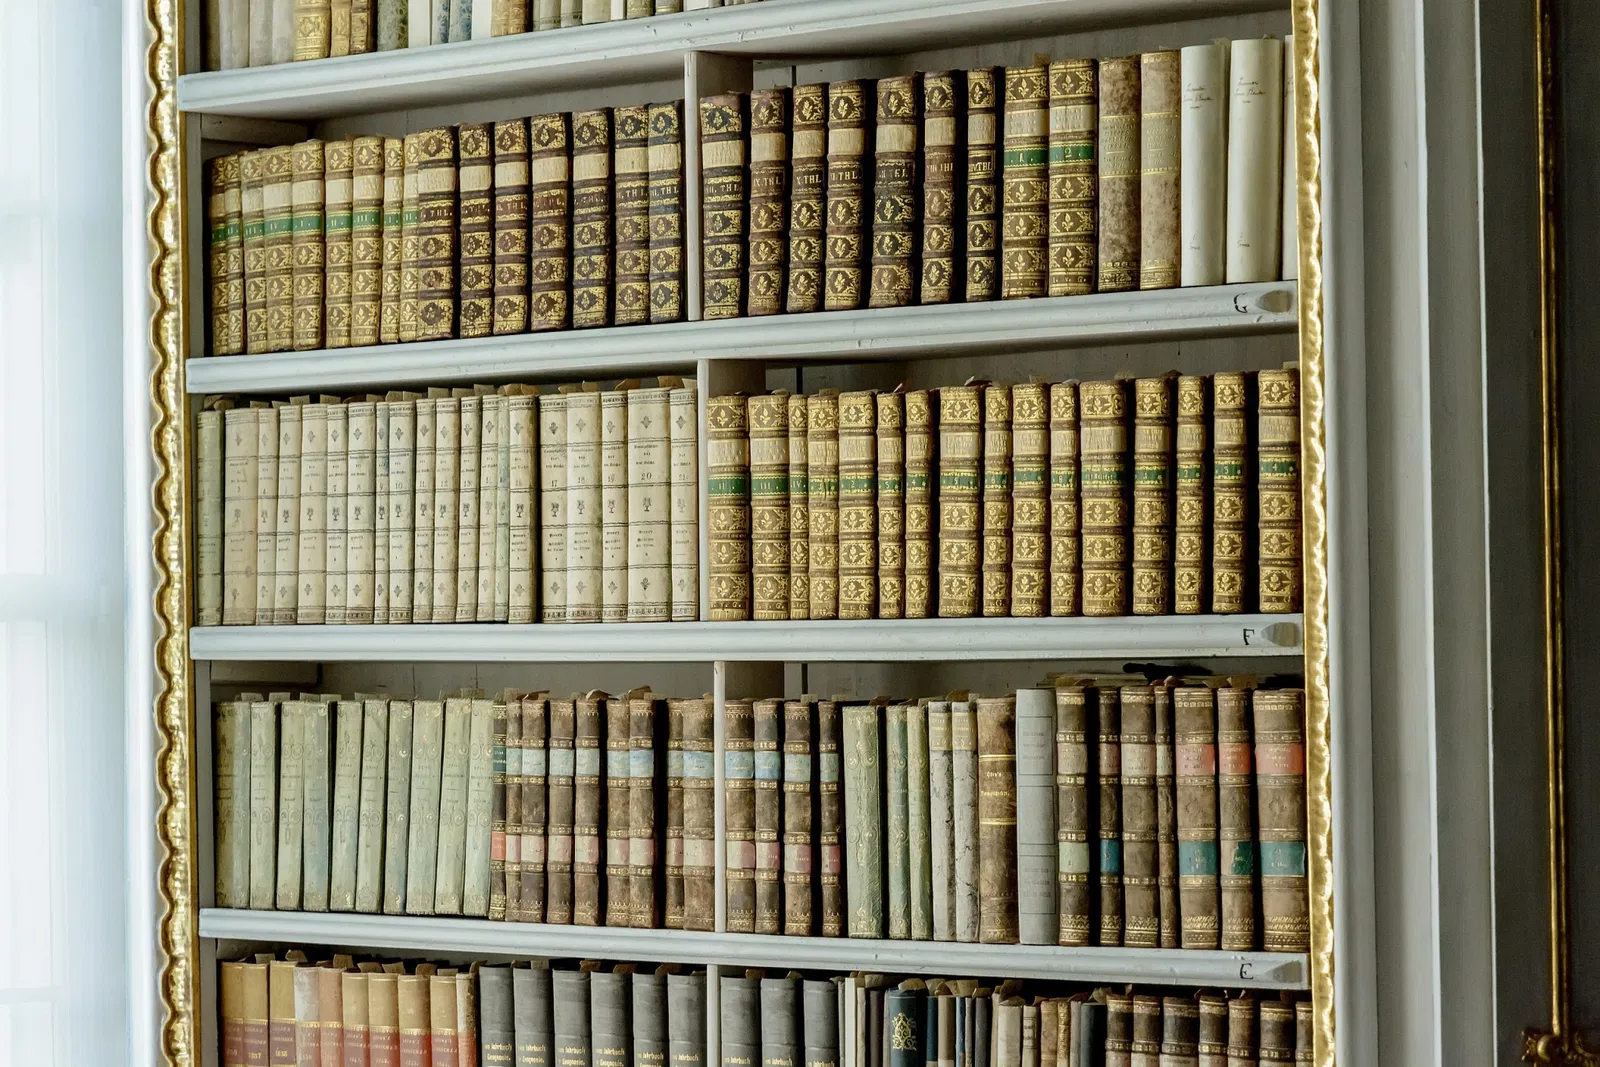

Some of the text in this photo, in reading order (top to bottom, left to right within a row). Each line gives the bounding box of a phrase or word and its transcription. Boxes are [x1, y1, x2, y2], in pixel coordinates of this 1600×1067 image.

[1233, 292, 1248, 313] G
[1243, 629, 1255, 645] F
[1240, 963, 1254, 979] E
